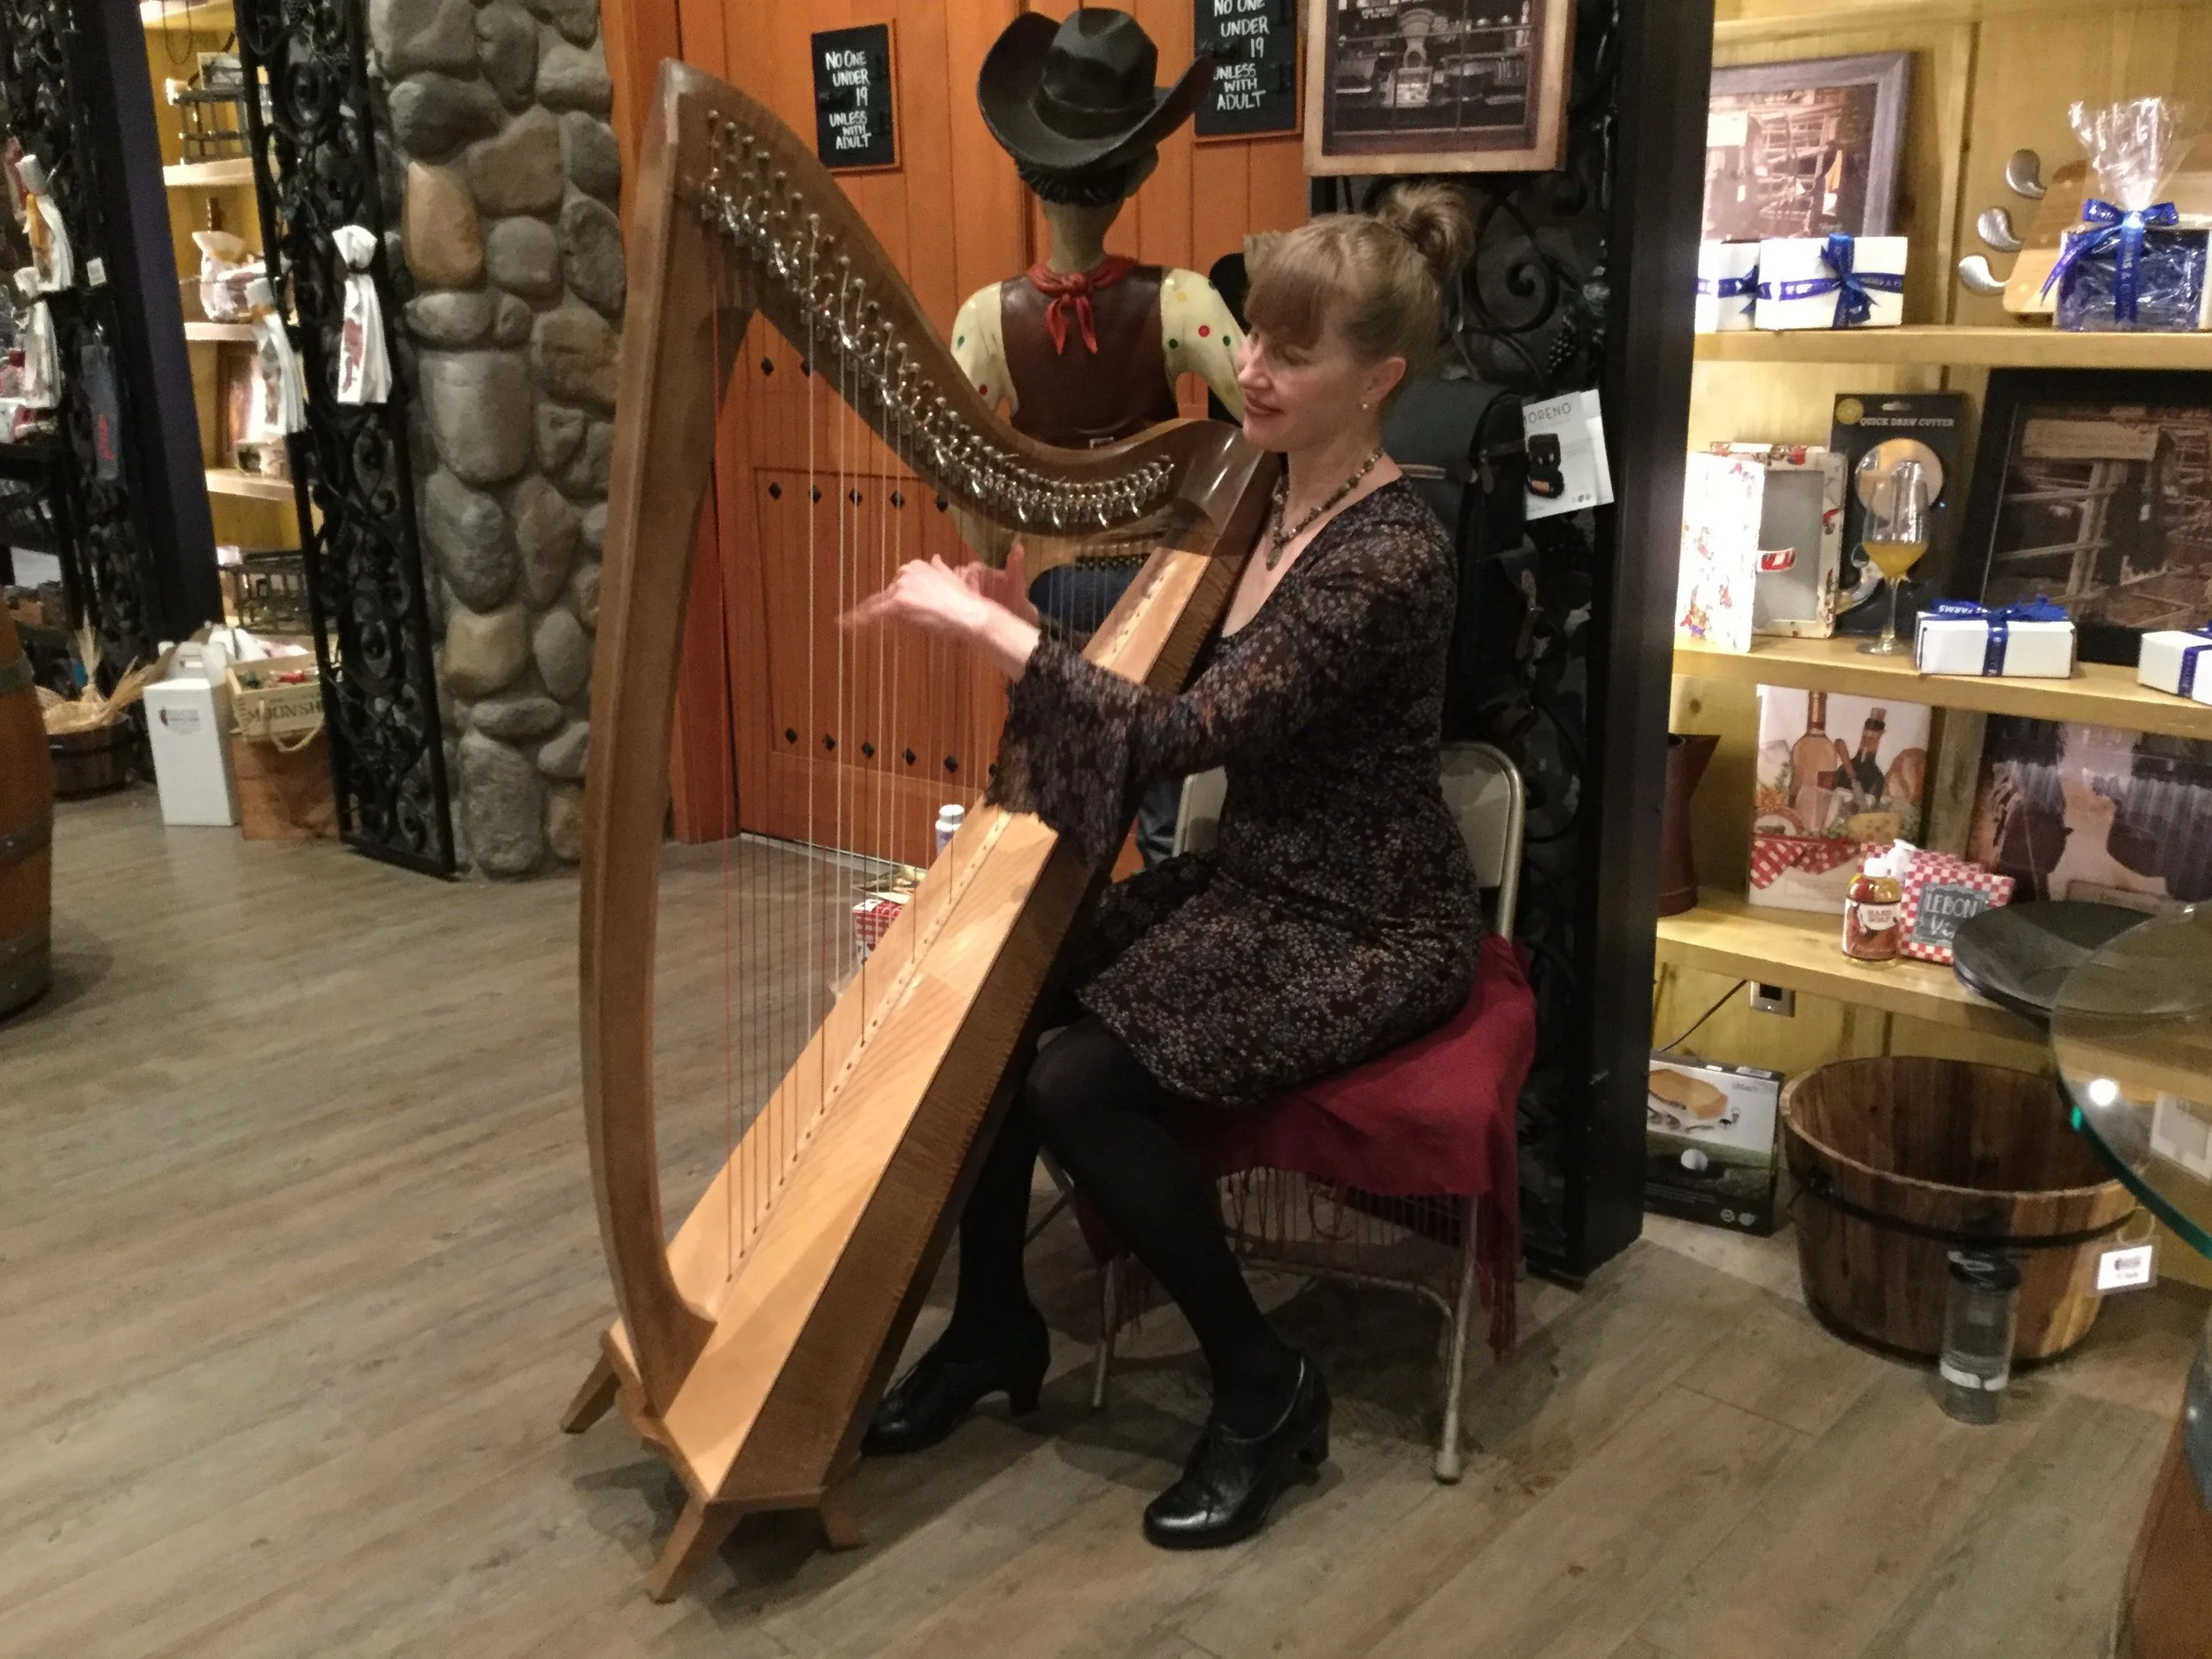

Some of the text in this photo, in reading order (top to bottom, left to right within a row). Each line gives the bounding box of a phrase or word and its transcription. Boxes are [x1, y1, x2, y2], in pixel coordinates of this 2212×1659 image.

[1214, 0, 1233, 17] NO
[1221, 16, 1270, 37] UNDER
[1250, 36, 1264, 58] 19
[826, 50, 867, 71] NO ONE
[833, 69, 871, 87] UNDER
[1225, 78, 1257, 92] WITH
[856, 87, 868, 106] 19
[1217, 89, 1266, 111] ADULT
[829, 111, 867, 127] UNLESS
[842, 124, 866, 136] WITH
[836, 133, 872, 150] ADULT
[1524, 402, 1571, 425] ORENO
[1860, 417, 1955, 427] QUICK DRAW CUTTER
[1939, 604, 1974, 614] FARMS
